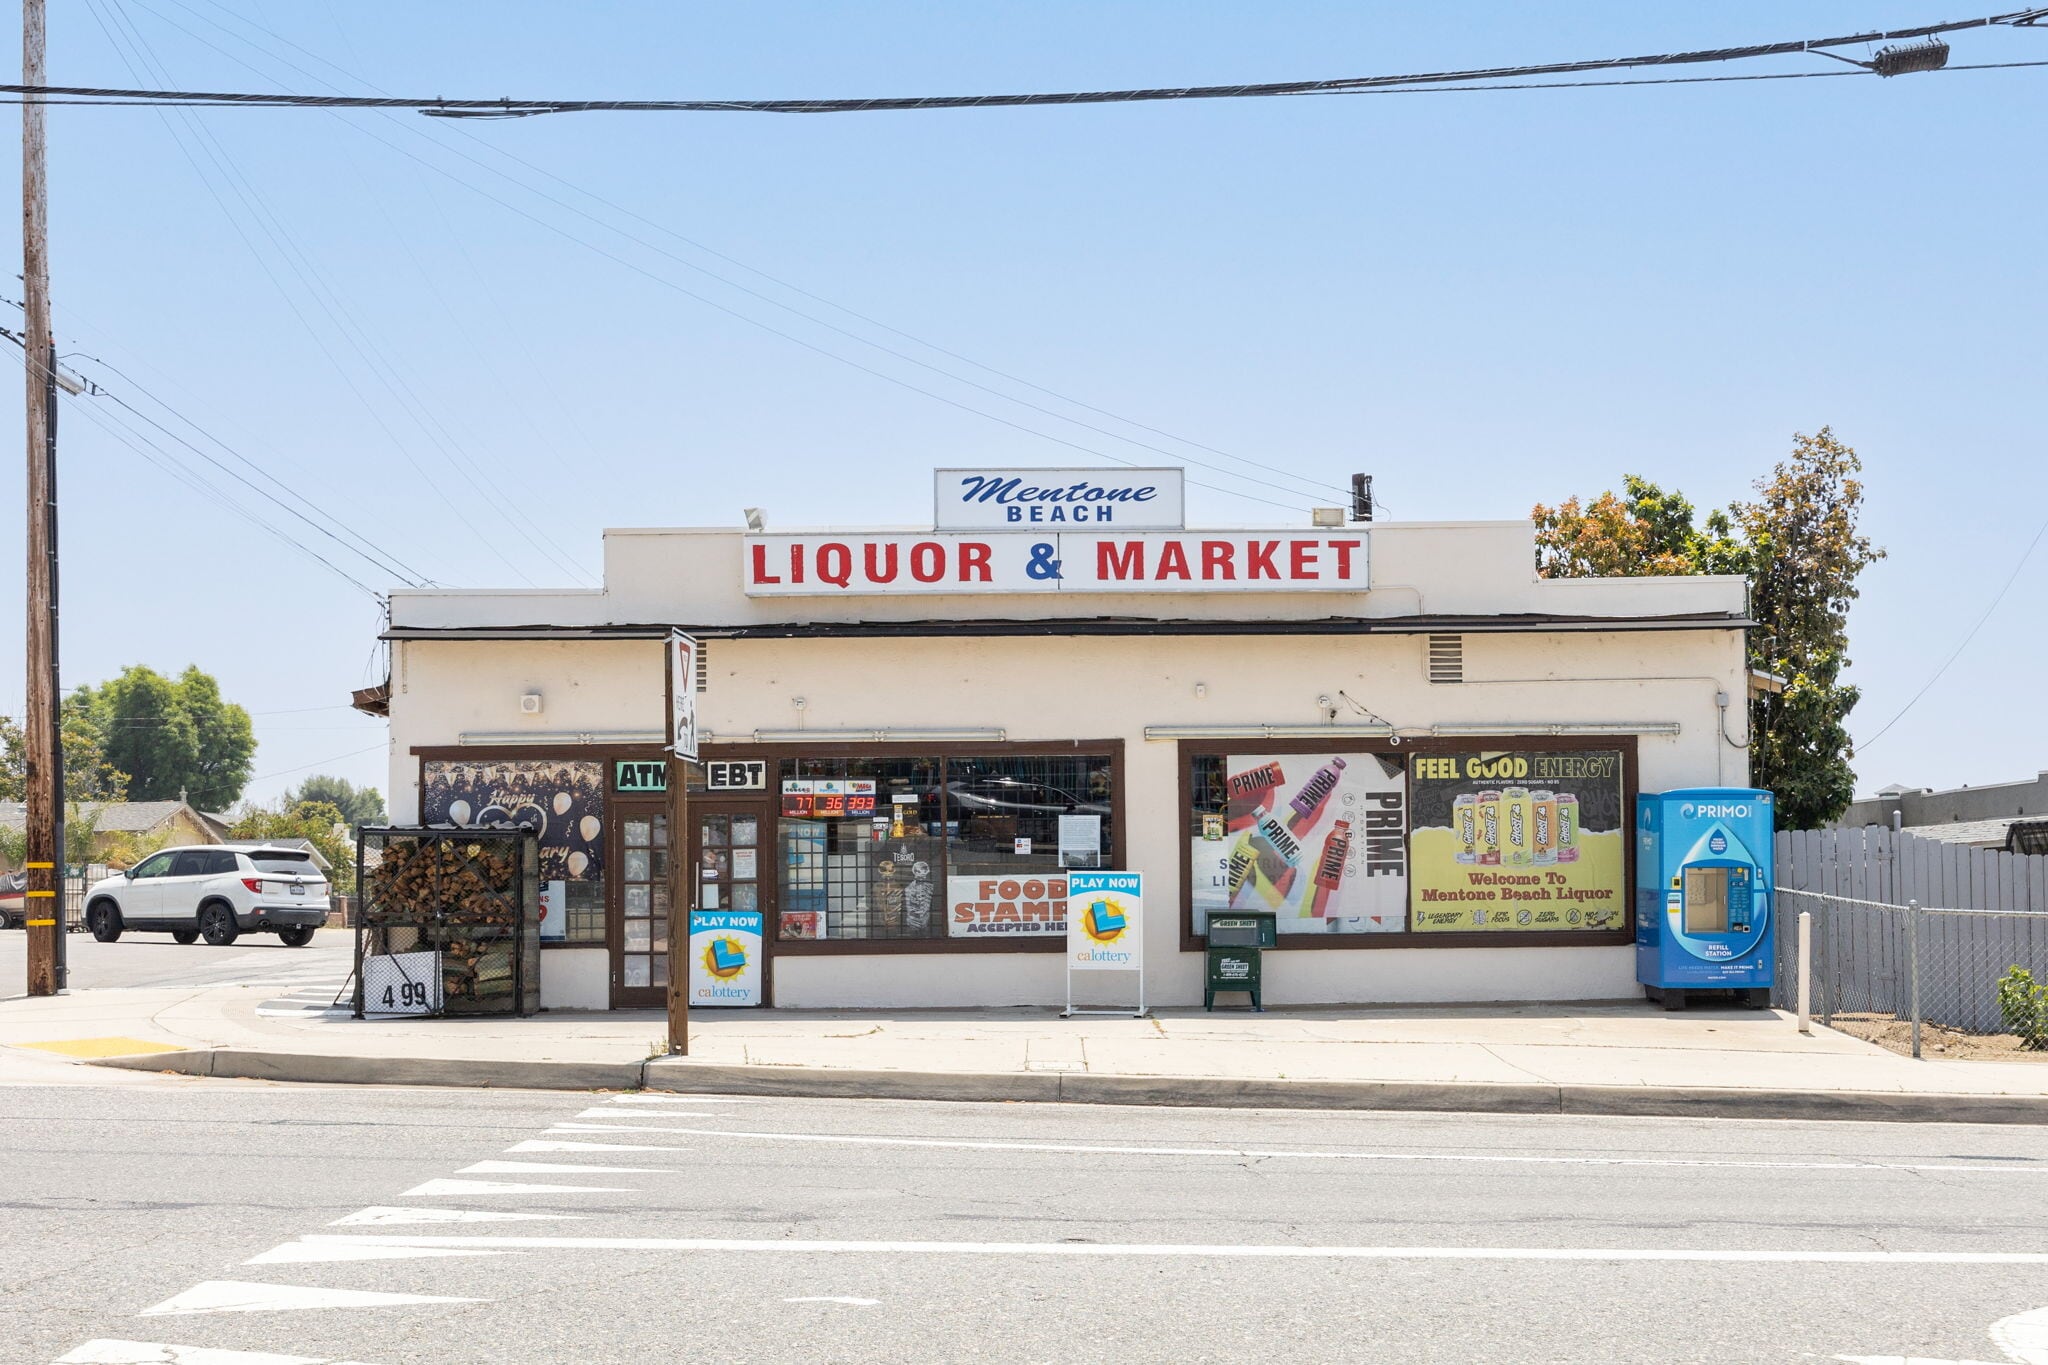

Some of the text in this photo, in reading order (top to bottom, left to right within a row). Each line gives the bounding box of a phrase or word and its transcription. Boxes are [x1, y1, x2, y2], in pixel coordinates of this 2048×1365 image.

[961, 475, 1158, 504] Mentone
[1007, 505, 1113, 522] BEACH
[752, 540, 1362, 589] LIQUOR & MARKET
[710, 763, 763, 786] EBT
[1415, 756, 1614, 779] FEEL GOOD ENERGY
[1233, 767, 1275, 795] PRIME
[1299, 768, 1337, 810] PRIME
[486, 789, 536, 808] Happy
[796, 797, 813, 809] 77
[825, 797, 843, 809] 36
[847, 797, 875, 810] 393
[1697, 805, 1748, 818] PRIMO
[1262, 819, 1300, 860] PRIME
[1365, 791, 1403, 877] PRIME
[893, 852, 915, 862] TESORO
[1321, 837, 1347, 881] PRIME
[1071, 878, 1138, 889] PLAY NOW
[1468, 872, 1567, 885] Welcome To
[978, 879, 1068, 901] FOOD
[1421, 886, 1614, 902] Mentone Beach Liquor
[693, 916, 759, 927] PLAY NOW
[954, 901, 1068, 924] STAMP
[966, 921, 1067, 933] ACCEPTED HE
[1077, 949, 1131, 964] calottery
[382, 982, 426, 1009] 4 99
[698, 985, 751, 1001] calottery
